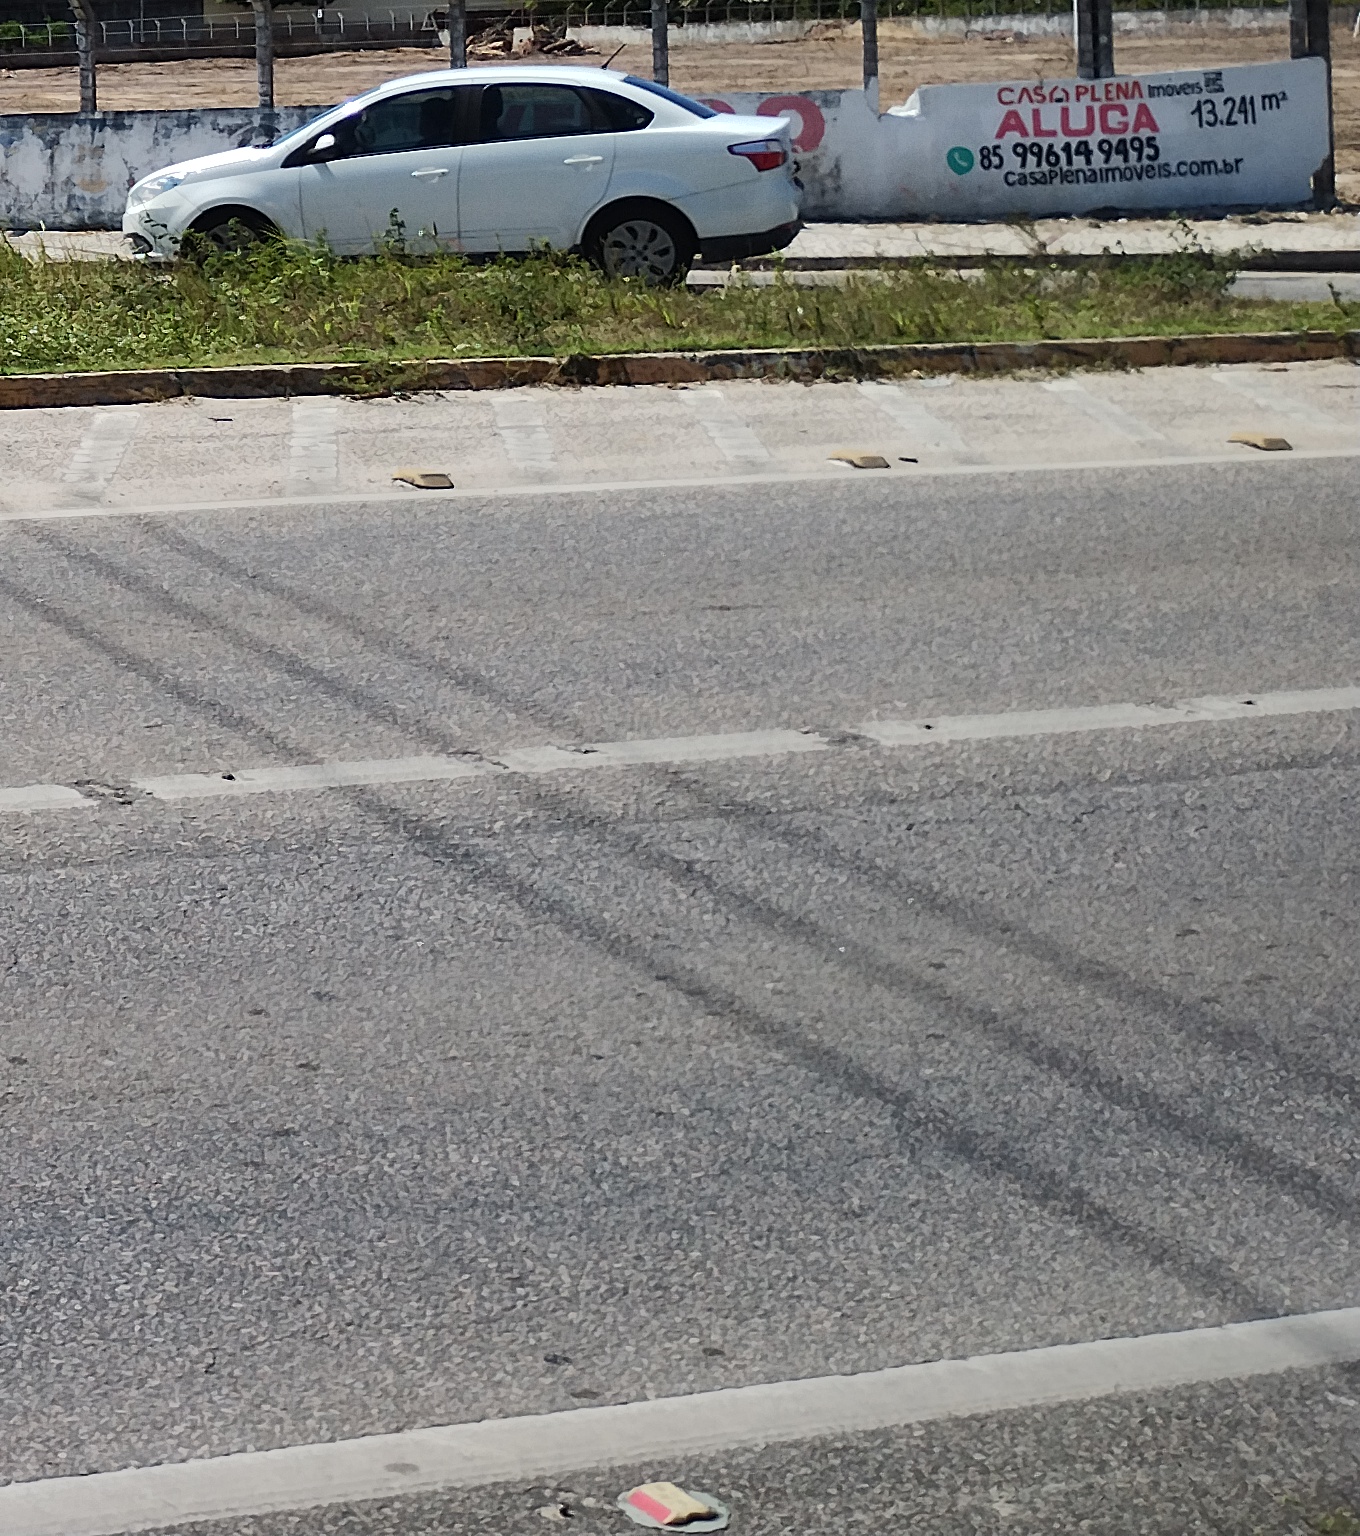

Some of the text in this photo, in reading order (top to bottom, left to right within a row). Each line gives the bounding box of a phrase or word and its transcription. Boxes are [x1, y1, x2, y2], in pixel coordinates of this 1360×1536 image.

[997, 85, 1070, 105] CASA
[1075, 80, 1144, 103] PLENA
[994, 103, 1160, 139] ALUGA
[1190, 94, 1257, 129] 13.241
[979, 144, 1005, 171] 85
